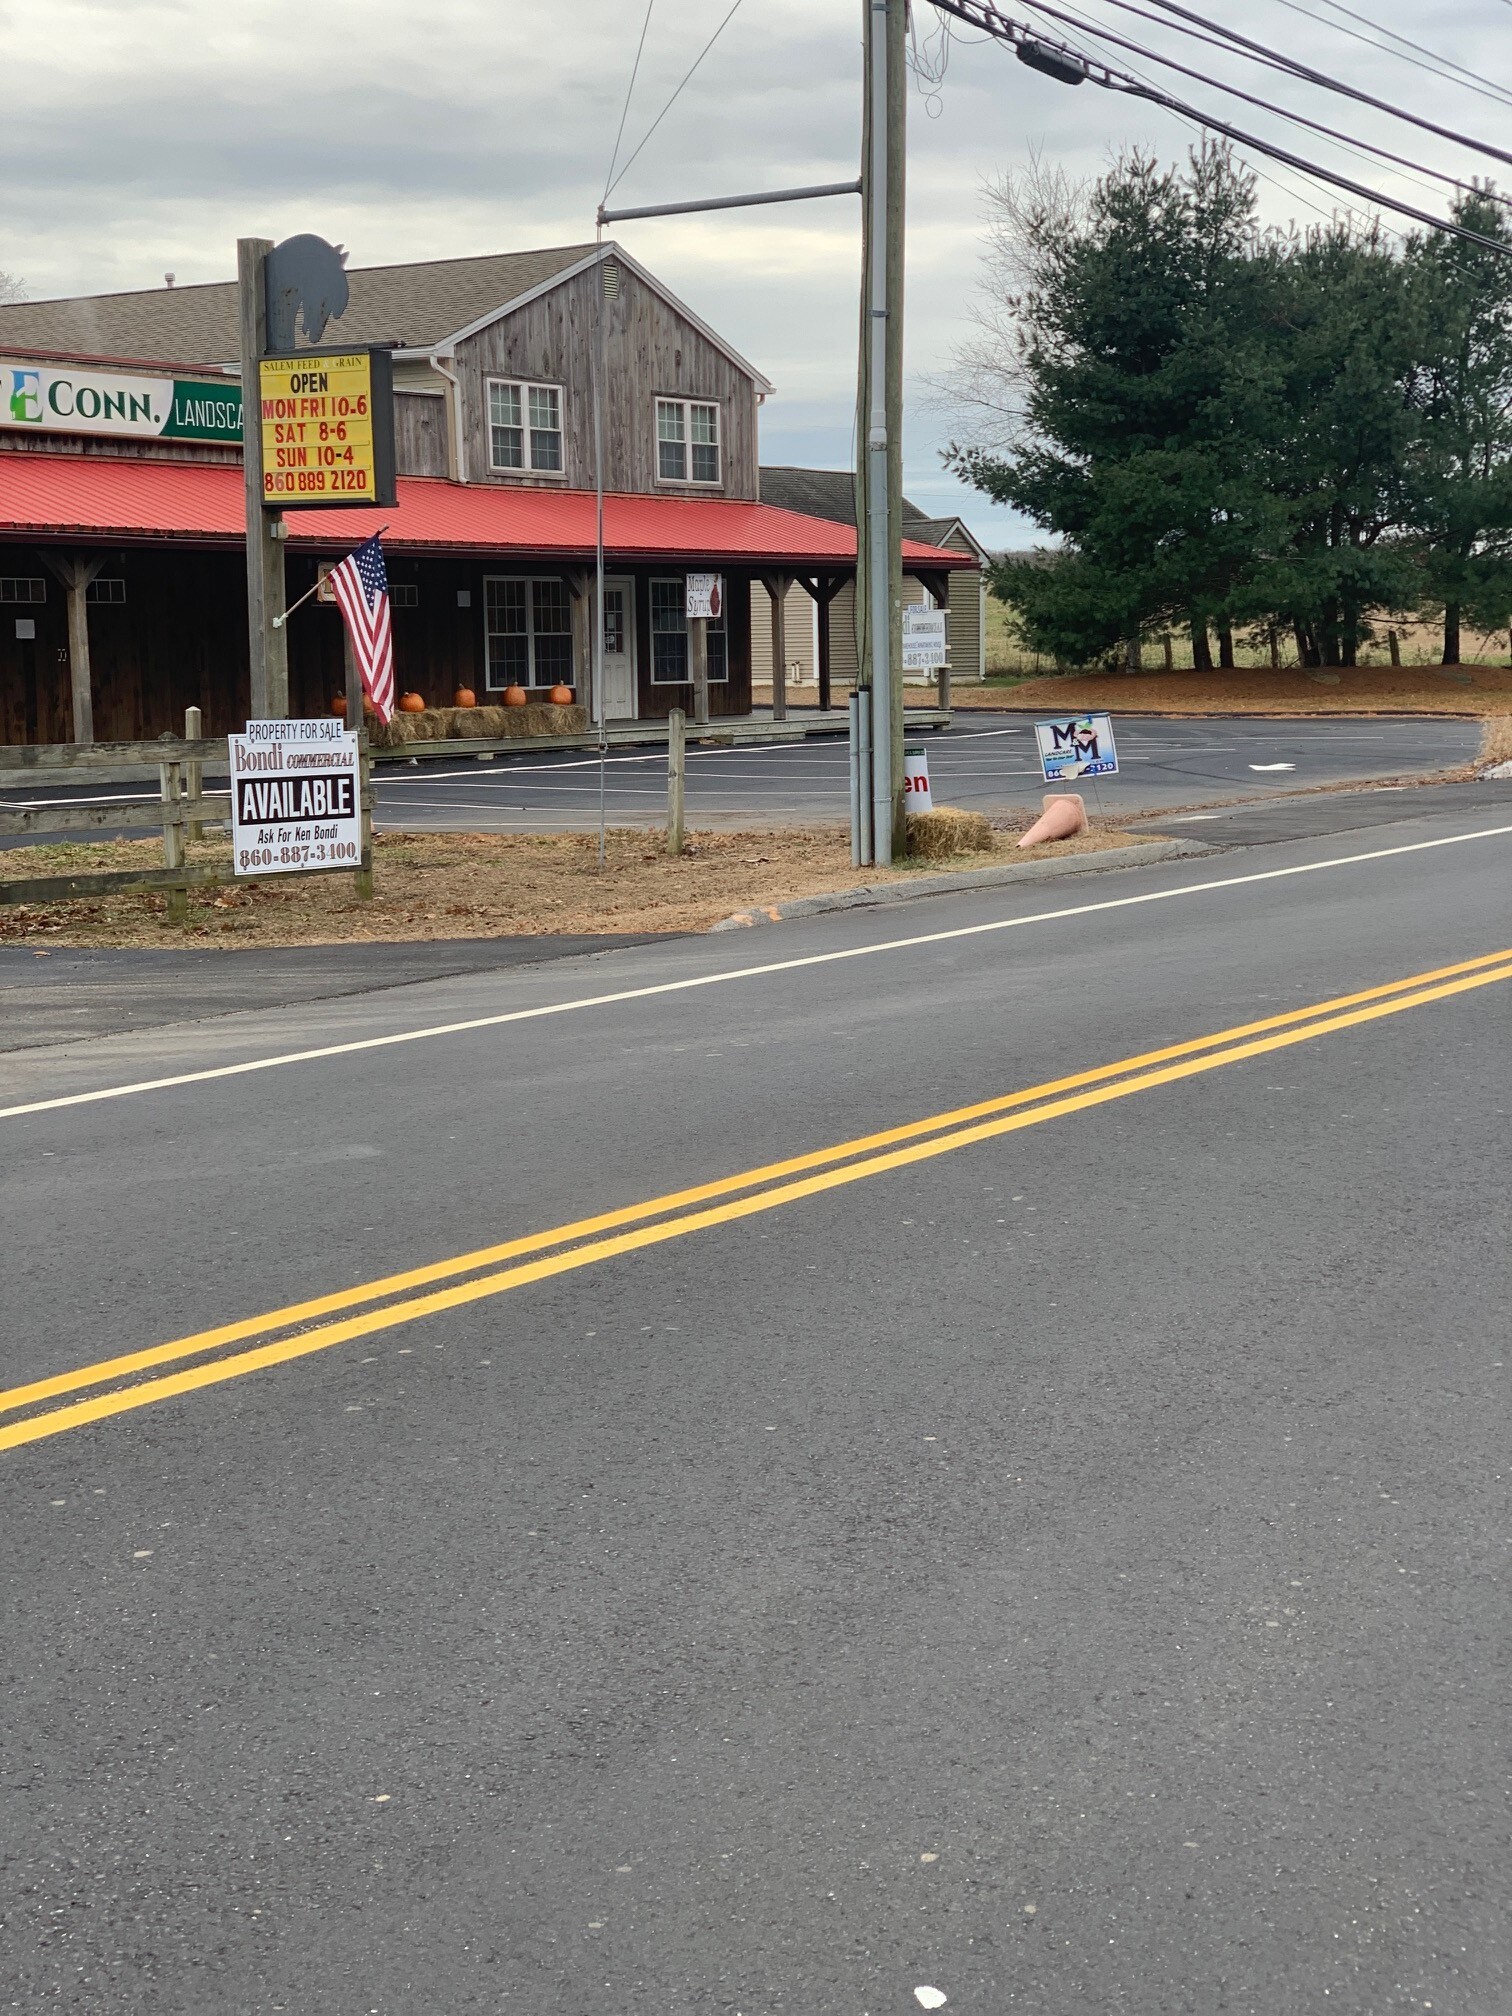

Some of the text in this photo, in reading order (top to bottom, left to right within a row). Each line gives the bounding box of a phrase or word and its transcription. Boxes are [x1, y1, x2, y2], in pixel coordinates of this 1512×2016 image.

[264, 361, 294, 371] SALEM
[297, 360, 320, 370] FEED
[333, 357, 362, 368] GRAIN
[290, 373, 328, 393] OPEN
[263, 395, 367, 419] MON FRI 10-6
[275, 421, 347, 443] SAT 8-6
[276, 446, 354, 467] SUN 10-4
[265, 470, 366, 491] 860 889 2120
[687, 575, 710, 595] Maple
[687, 596, 710, 616] Syrup
[249, 722, 342, 740] PROPERTY FOR SALE
[234, 743, 355, 772] Bondi COMMERCIAL
[243, 778, 351, 820] AVAILABLE
[257, 824, 338, 844] Ask For Ken Bondi
[240, 842, 356, 867] 860-887-3400
